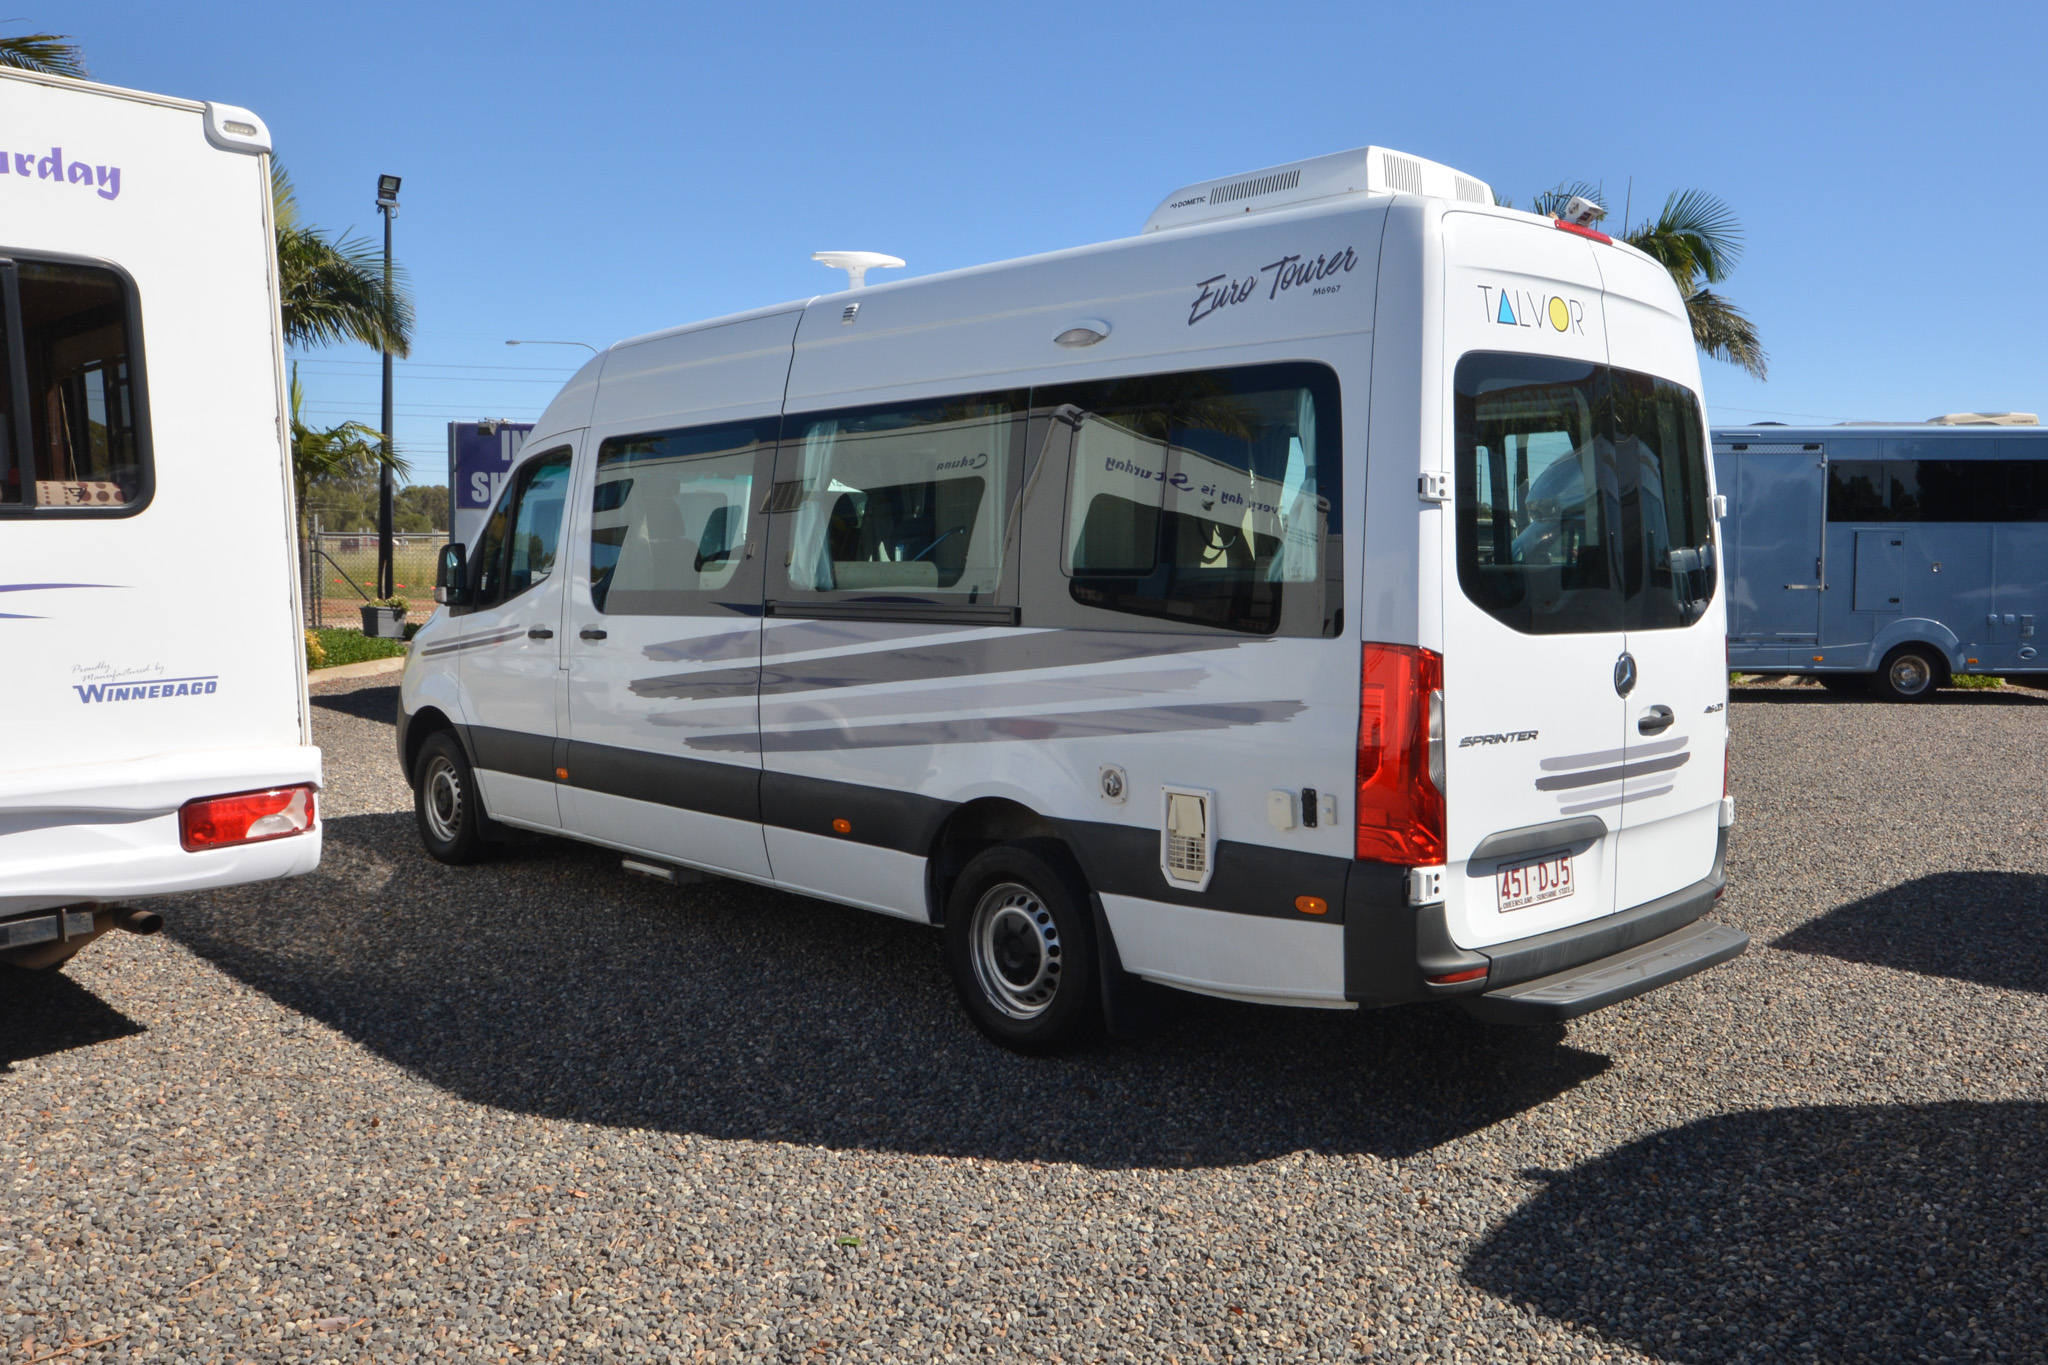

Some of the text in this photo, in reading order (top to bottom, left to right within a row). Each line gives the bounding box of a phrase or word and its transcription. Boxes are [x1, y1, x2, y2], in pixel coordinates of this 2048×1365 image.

[1178, 196, 1206, 208] DOMETIC
[1188, 246, 1358, 326] Euro Tourer
[1312, 285, 1341, 296] M6967
[1477, 285, 1584, 336] TALVOR
[71, 661, 110, 674] Proudly
[154, 662, 165, 675] by
[73, 675, 218, 704] WINNEBAGO
[1458, 730, 1539, 748] SPRINTER
